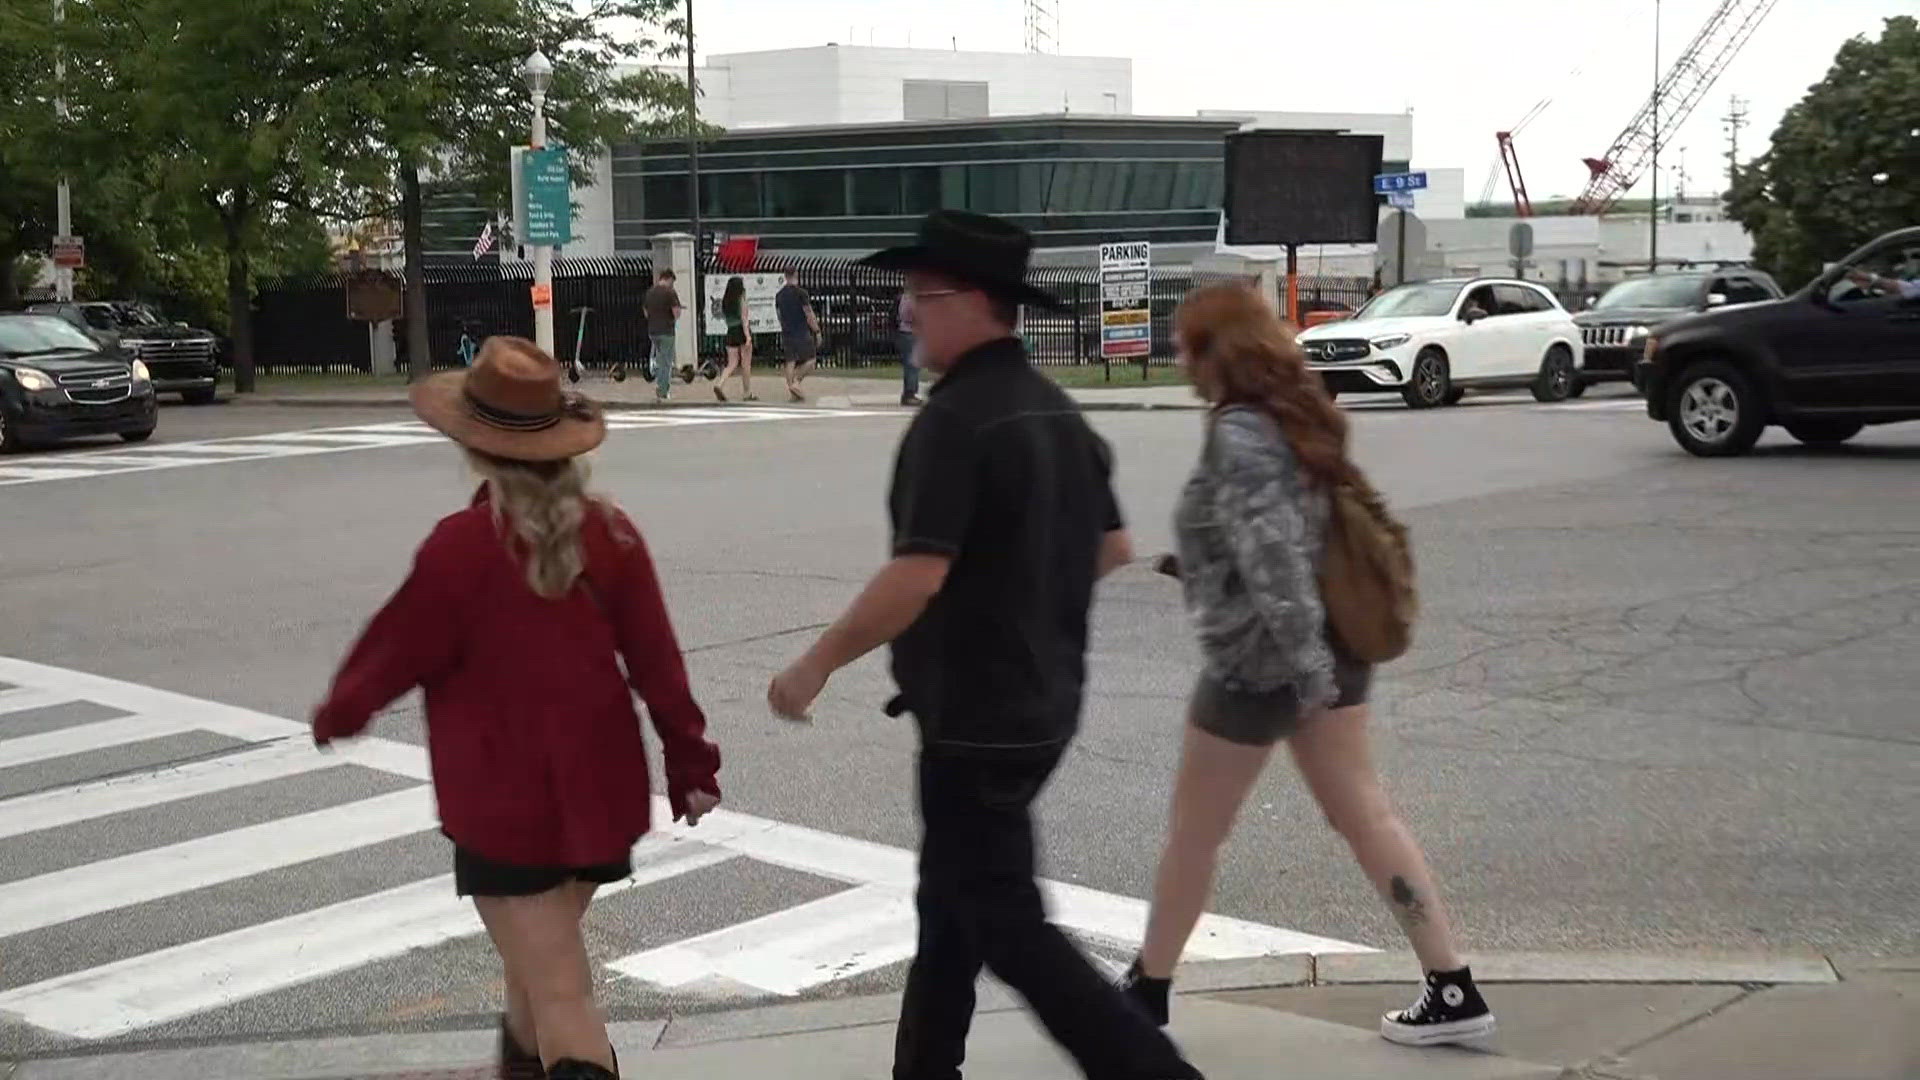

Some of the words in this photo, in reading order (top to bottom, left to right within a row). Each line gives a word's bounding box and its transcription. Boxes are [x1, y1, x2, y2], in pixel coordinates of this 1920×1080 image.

[1382, 178, 1391, 189] E
[1396, 177, 1404, 188] 9
[1407, 175, 1420, 187] St
[1102, 244, 1148, 260] PARKING
